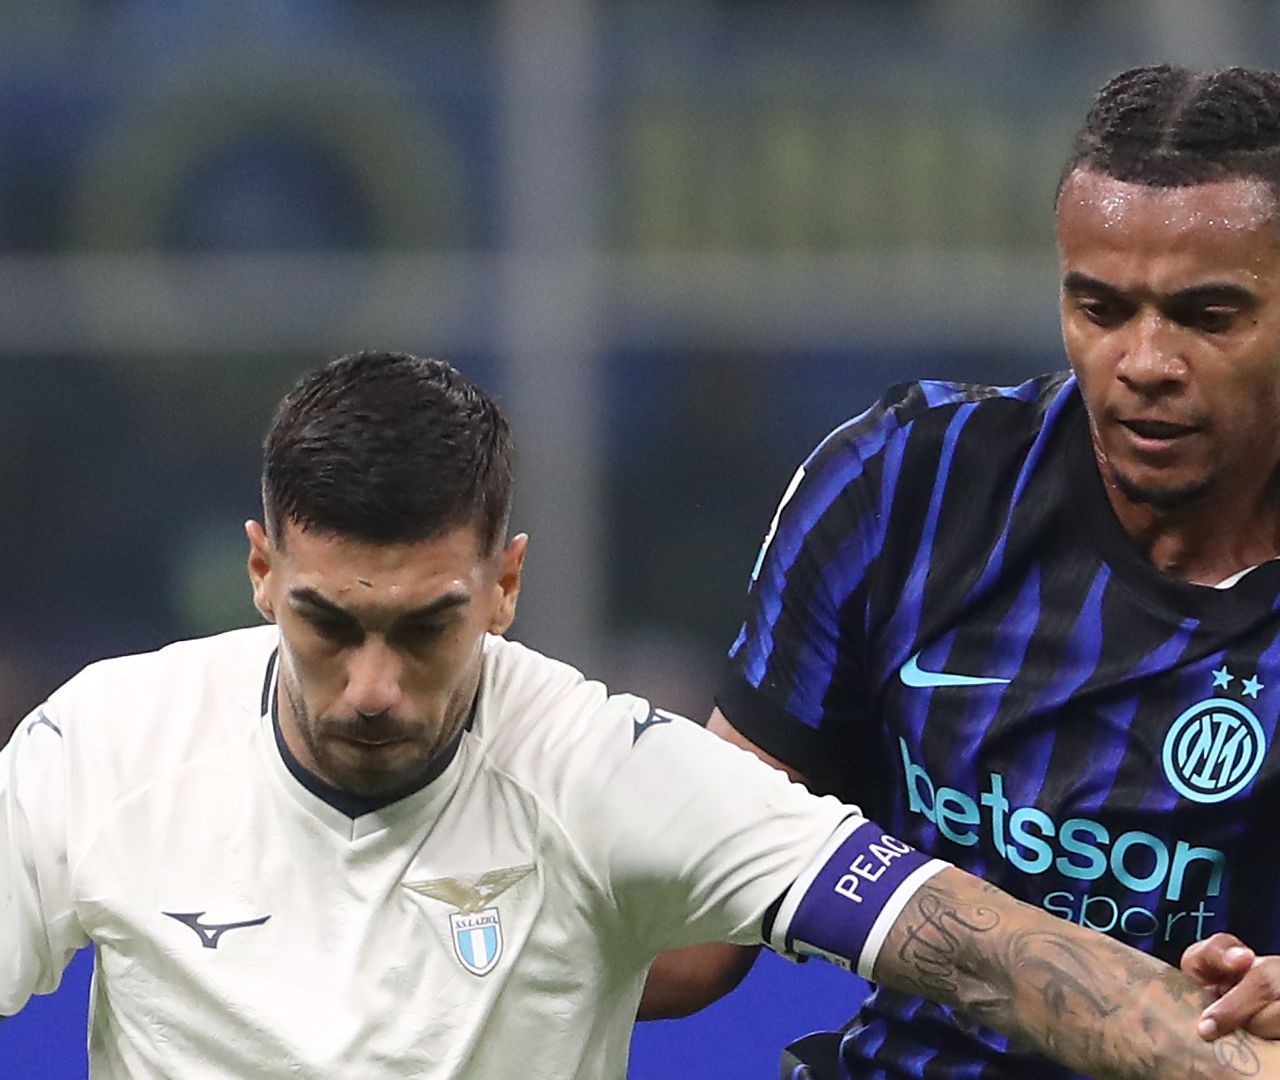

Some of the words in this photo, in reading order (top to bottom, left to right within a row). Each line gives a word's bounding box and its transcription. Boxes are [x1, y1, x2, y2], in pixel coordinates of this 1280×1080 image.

[899, 735, 1226, 902] betsson
[834, 834, 916, 904] PEAC
[1042, 891, 1216, 942] sport
